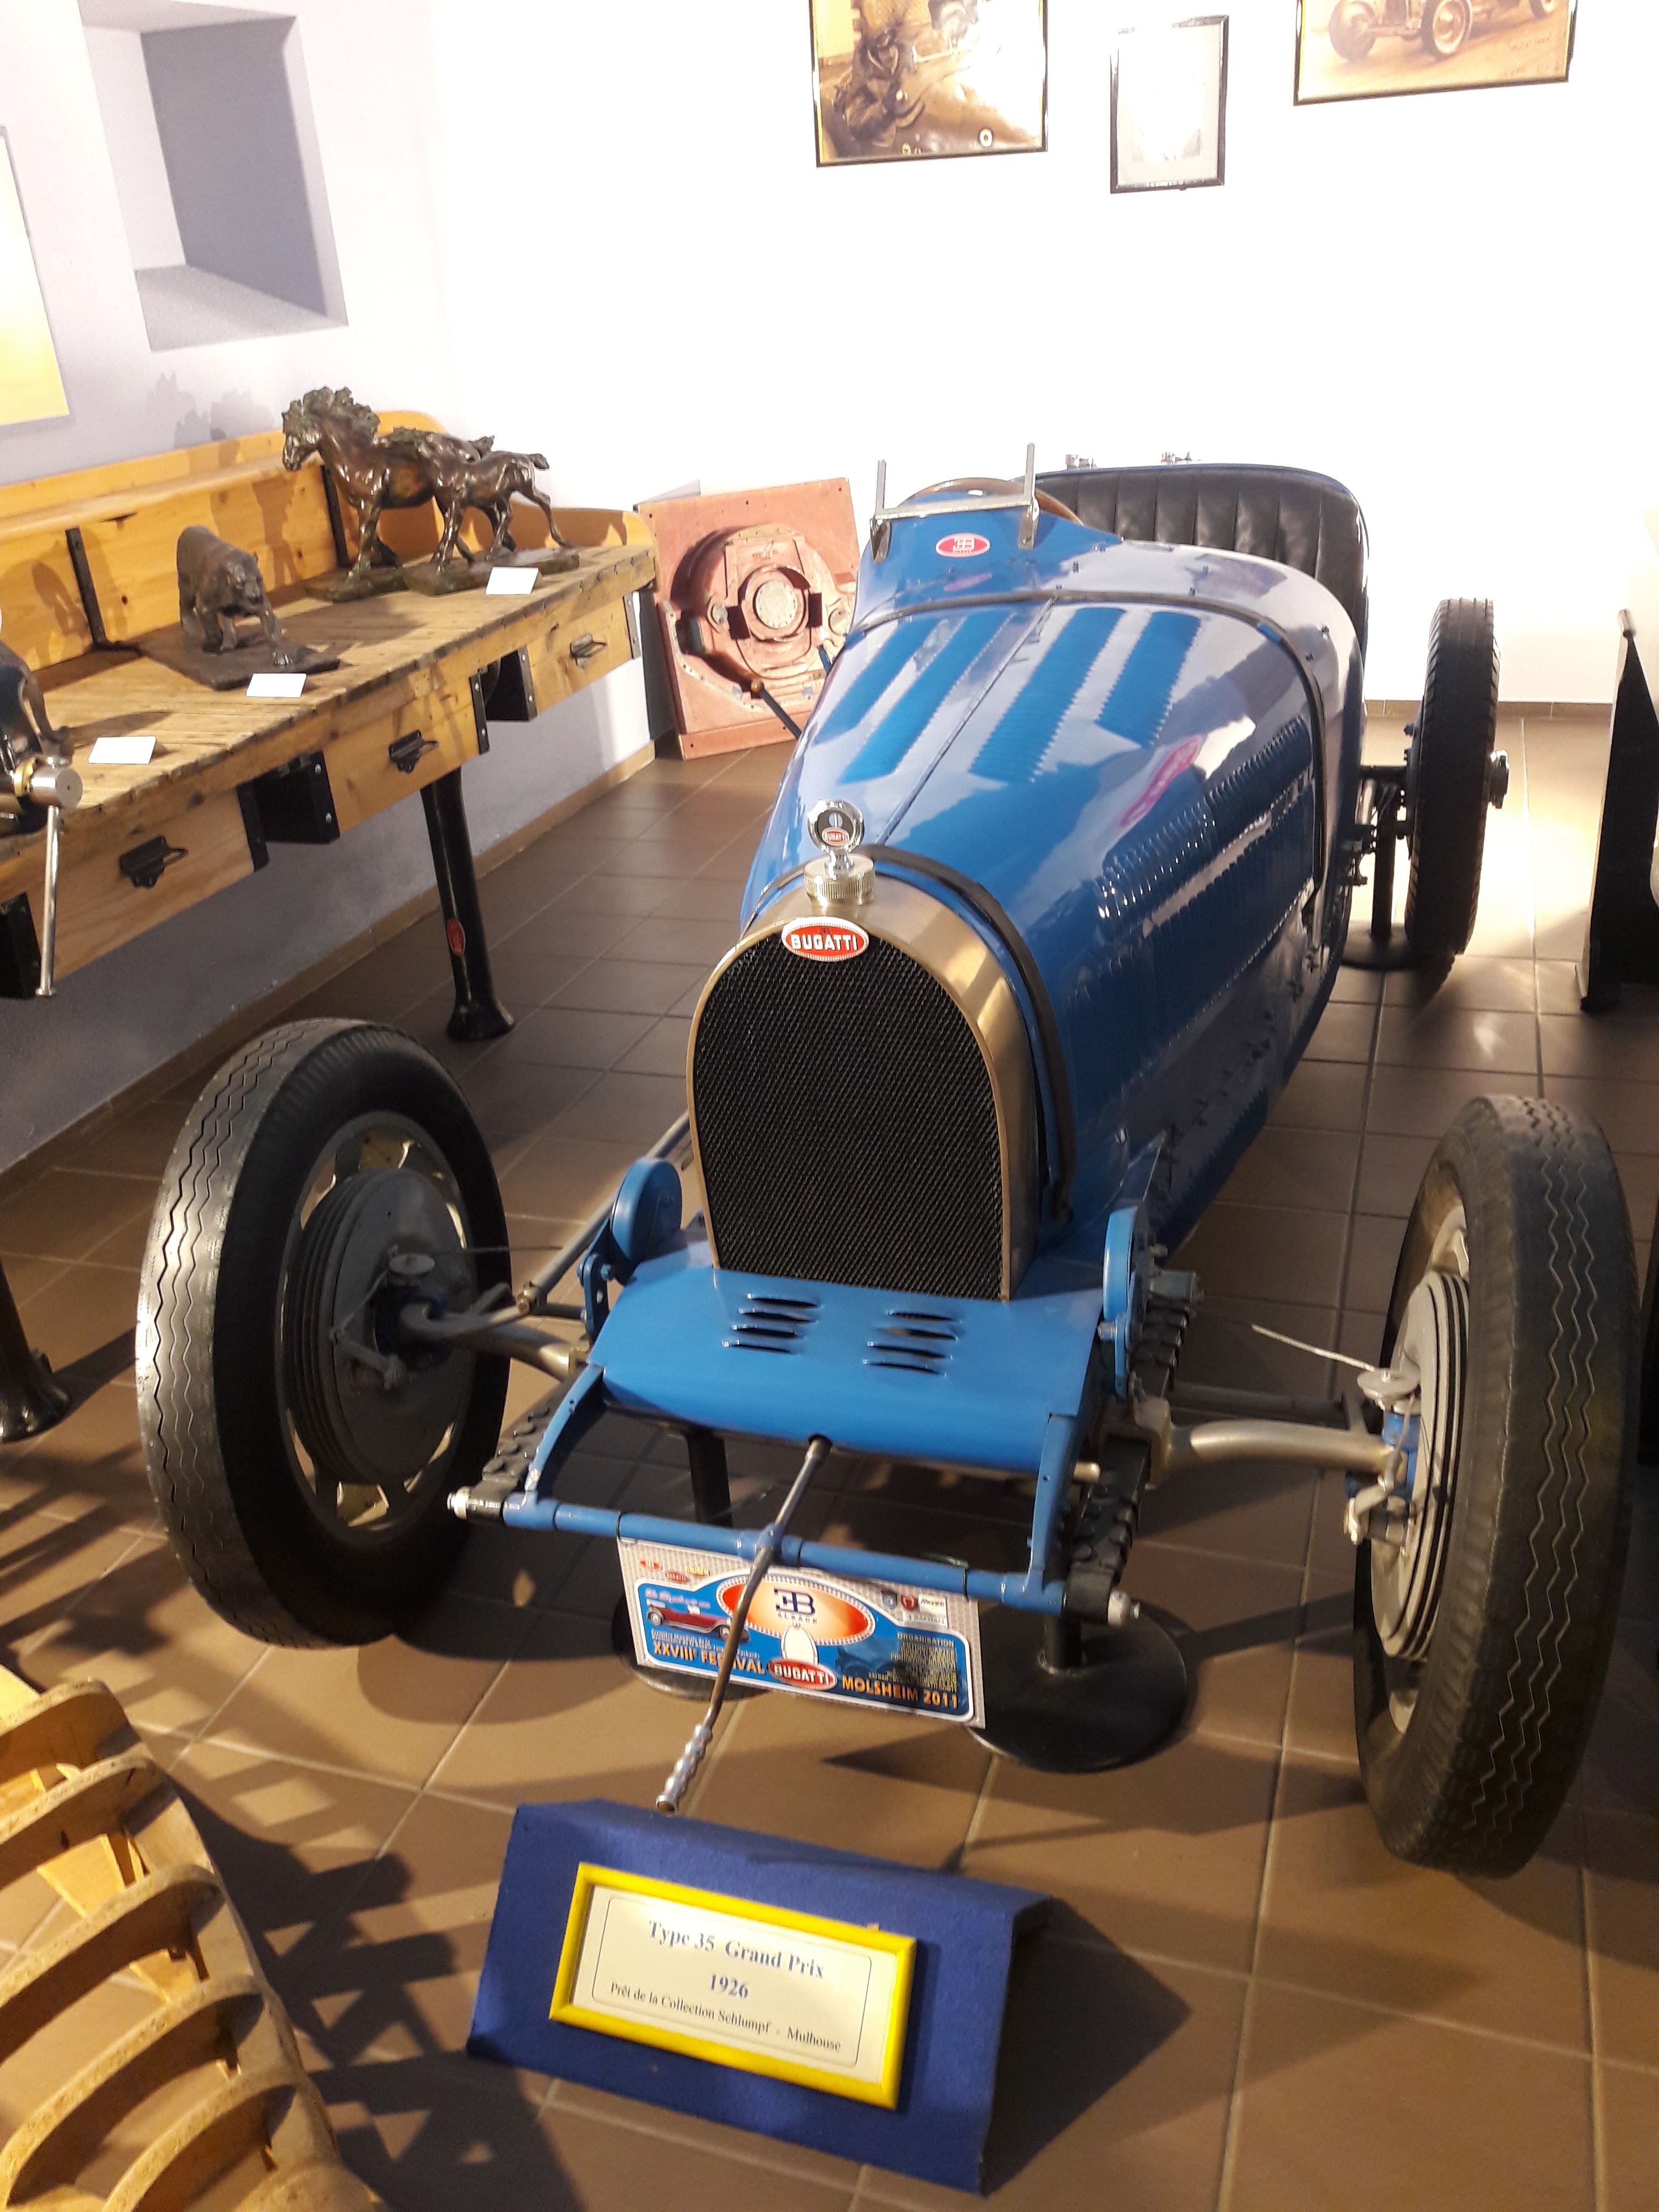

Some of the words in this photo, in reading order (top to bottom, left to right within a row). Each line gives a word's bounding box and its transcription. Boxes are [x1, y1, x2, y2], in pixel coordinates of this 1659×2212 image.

[790, 934, 858, 951] BUGATTI
[774, 1663, 830, 1686] BUGATTI
[842, 1674, 919, 1702] MOLSHEIM
[923, 1688, 958, 1709] 2011
[649, 1919, 690, 1948] Type
[694, 1932, 715, 1952] 35
[725, 1940, 782, 1969] Grand
[788, 1953, 824, 1979] Prix
[711, 1974, 749, 1999] 1926
[610, 1981, 631, 1999] Prêt
[634, 1988, 646, 2001] de
[649, 1991, 658, 2005] la
[662, 1995, 714, 2020] Collection
[719, 2009, 772, 2035] Schlumpf
[787, 2026, 841, 2052] Mulhouse
